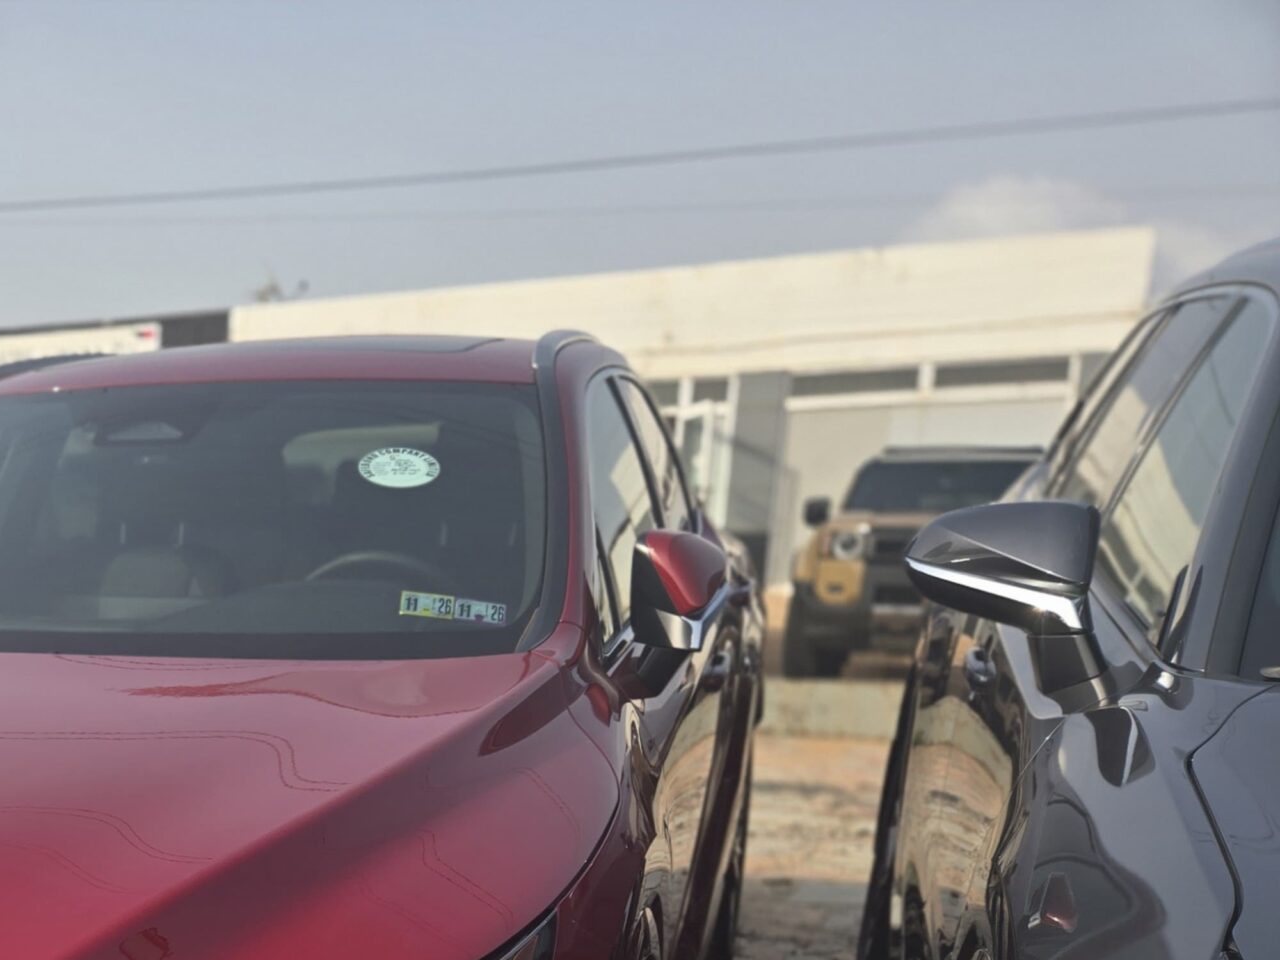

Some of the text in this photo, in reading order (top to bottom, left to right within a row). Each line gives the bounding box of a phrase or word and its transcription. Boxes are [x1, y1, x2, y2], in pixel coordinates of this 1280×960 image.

[380, 448, 425, 458] COMPANY
[405, 597, 452, 615] 11 26
[459, 603, 505, 622] 11 26
